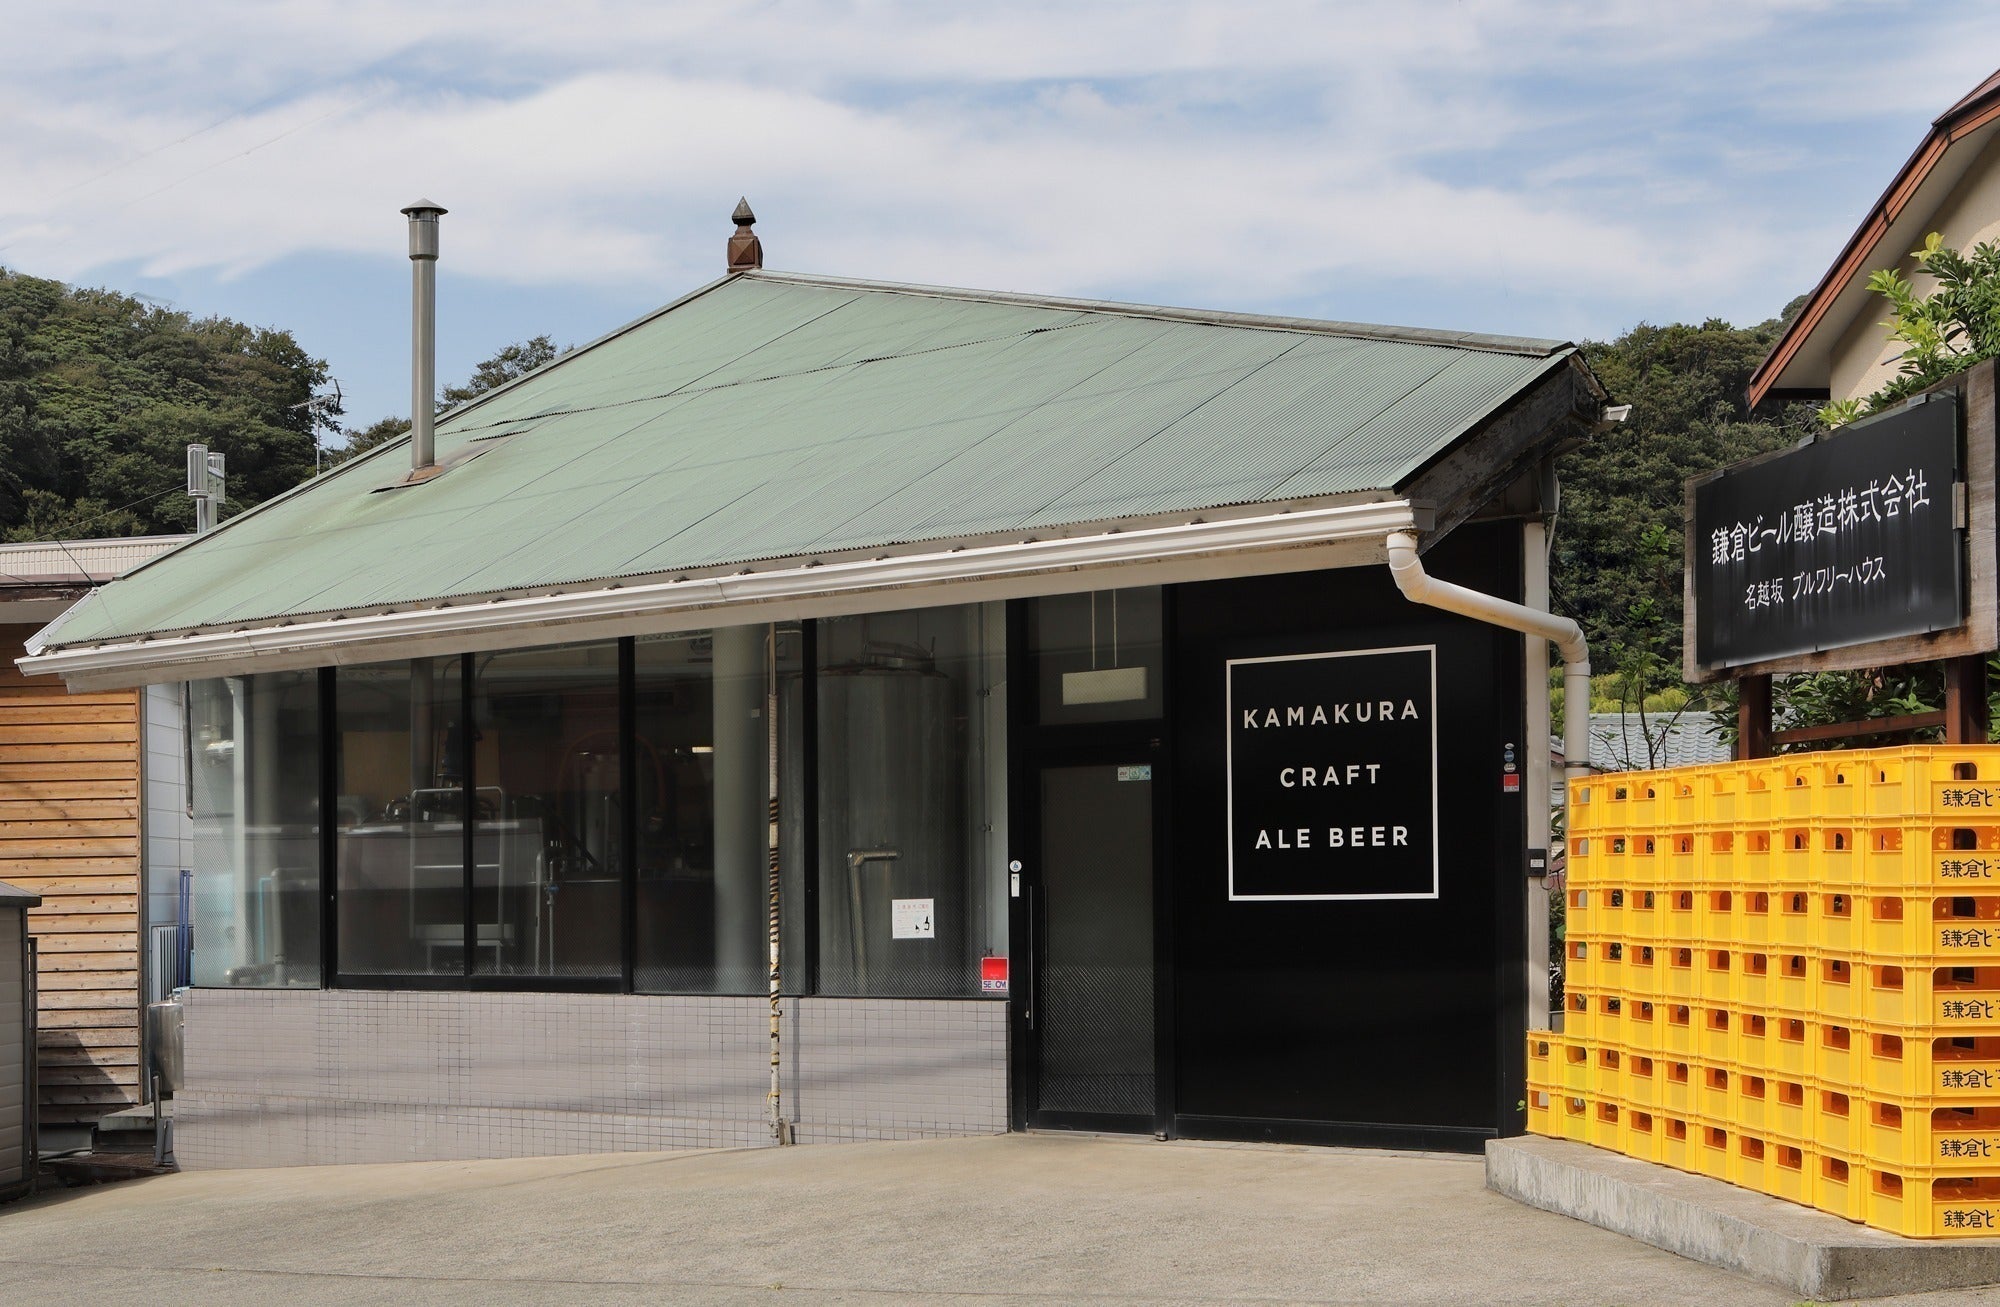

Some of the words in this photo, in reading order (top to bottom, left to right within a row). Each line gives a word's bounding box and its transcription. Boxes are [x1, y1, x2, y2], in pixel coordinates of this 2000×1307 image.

[1711, 467, 1931, 566] 鎌倉ビール醸造株式会社
[1744, 576, 1785, 610] 名越坂
[1791, 555, 1886, 600] ブルワリーハウス
[1244, 700, 1418, 728] KAMAKURA
[1280, 764, 1380, 787] CRAFT
[1256, 829, 1310, 849] ALE
[1330, 826, 1407, 847] BEER
[983, 980, 1007, 989] SEOM
